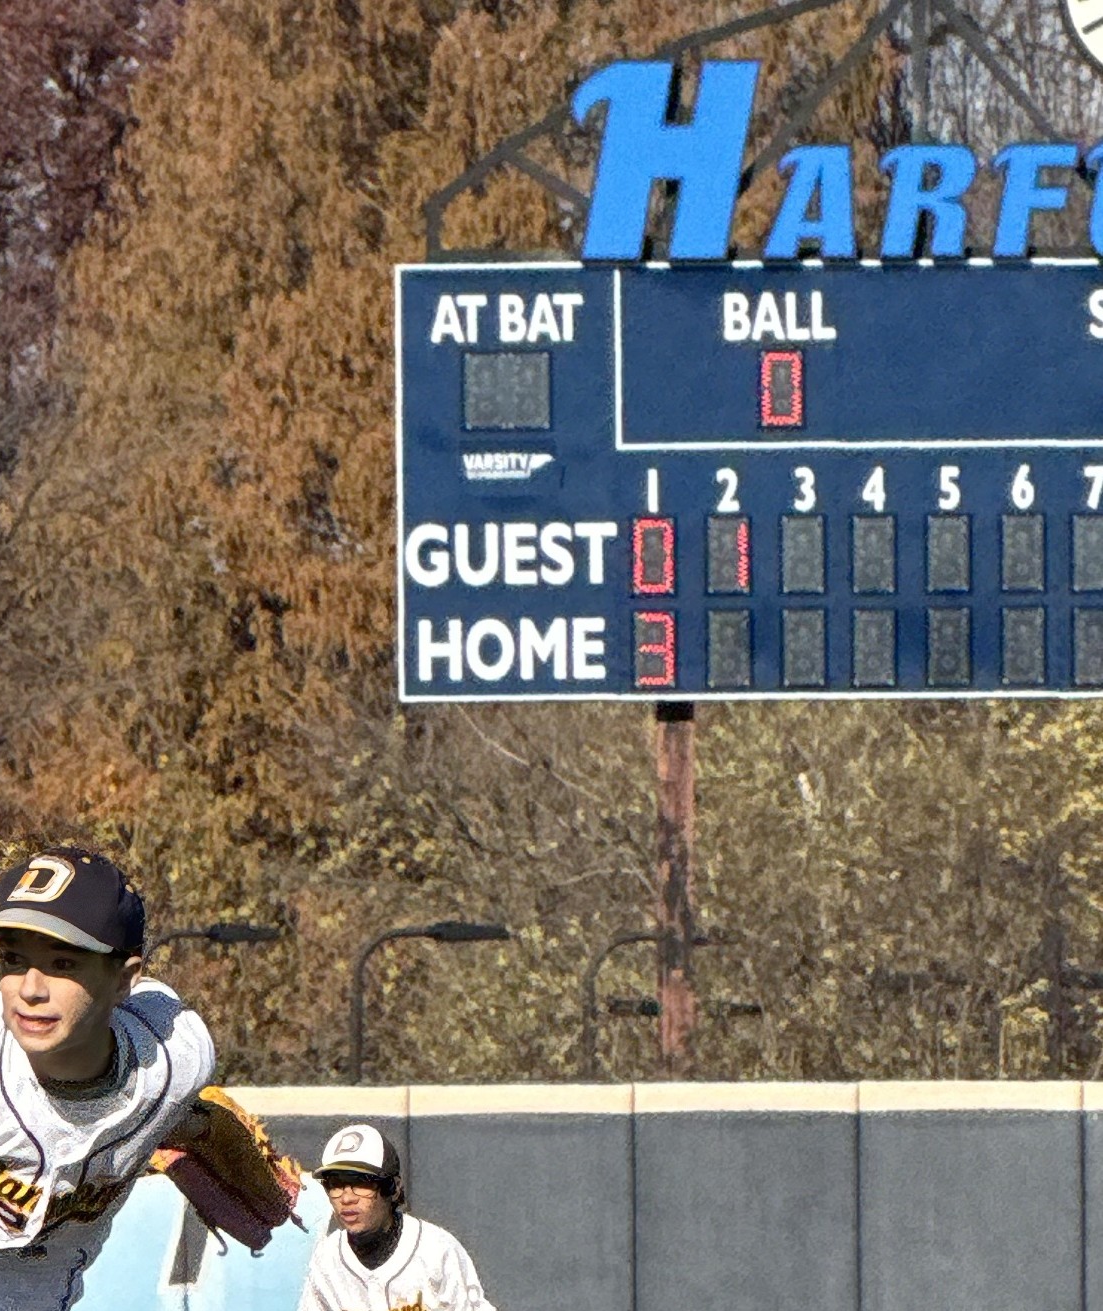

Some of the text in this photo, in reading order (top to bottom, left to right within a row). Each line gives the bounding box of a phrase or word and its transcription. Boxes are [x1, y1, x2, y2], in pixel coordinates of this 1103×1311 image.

[572, 60, 1103, 259] HARF
[430, 293, 584, 344] AT BAT
[723, 291, 837, 342] BALL
[761, 351, 803, 425] 0
[462, 453, 530, 471] VARSITY
[646, 463, 1103, 513] 1 2 3 4 5 6 7
[404, 521, 618, 587] GUEST
[633, 518, 749, 593] 0 1
[417, 616, 607, 682] HOME
[635, 611, 675, 686] 3
[6, 855, 76, 902] D
[334, 1131, 365, 1155] D
